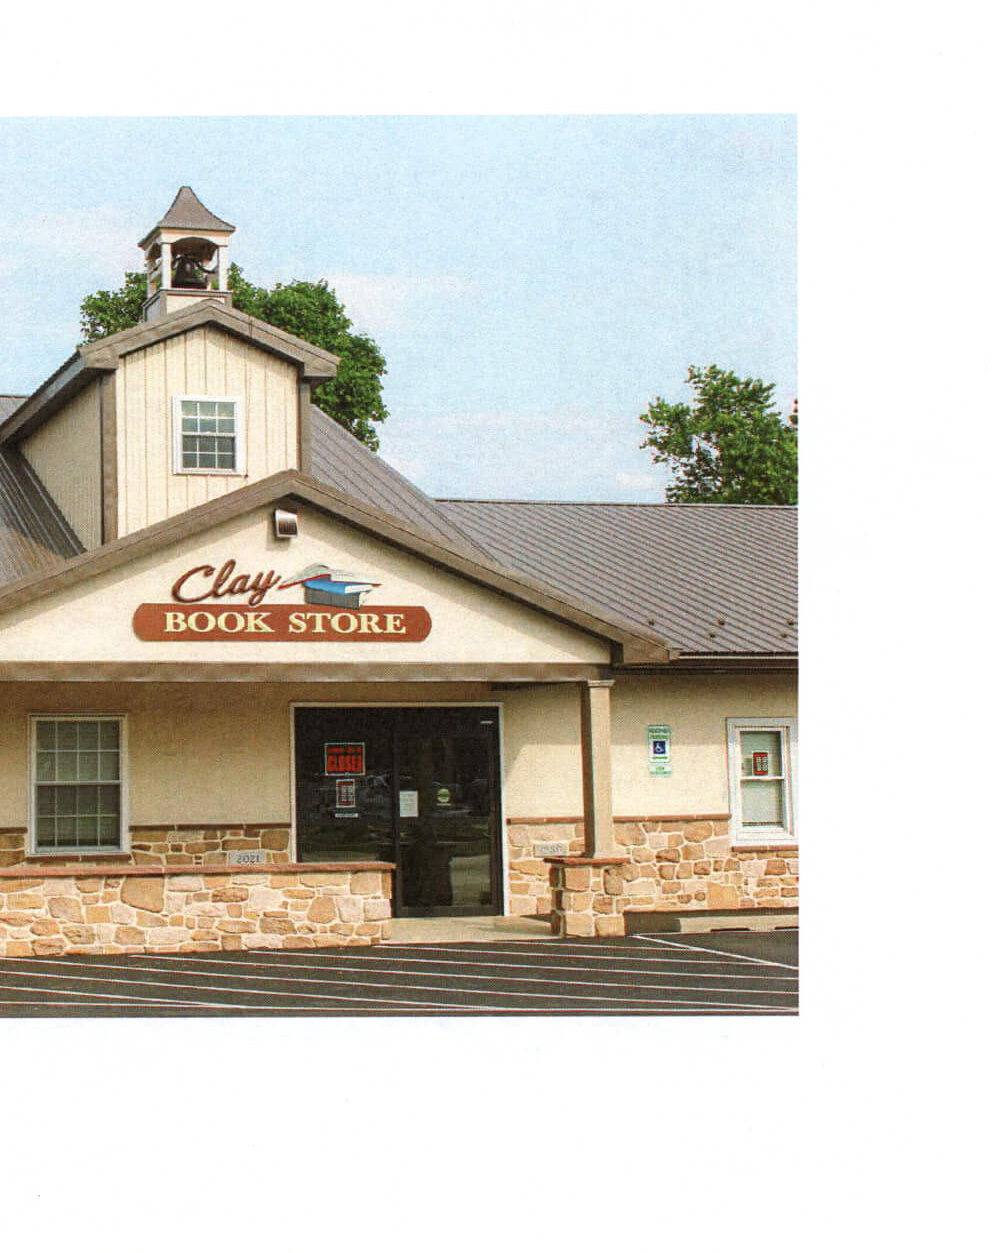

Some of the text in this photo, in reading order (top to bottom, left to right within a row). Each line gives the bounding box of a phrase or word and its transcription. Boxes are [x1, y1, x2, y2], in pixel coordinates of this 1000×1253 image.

[171, 558, 281, 606] Clay
[164, 611, 406, 634] BOOK STORE
